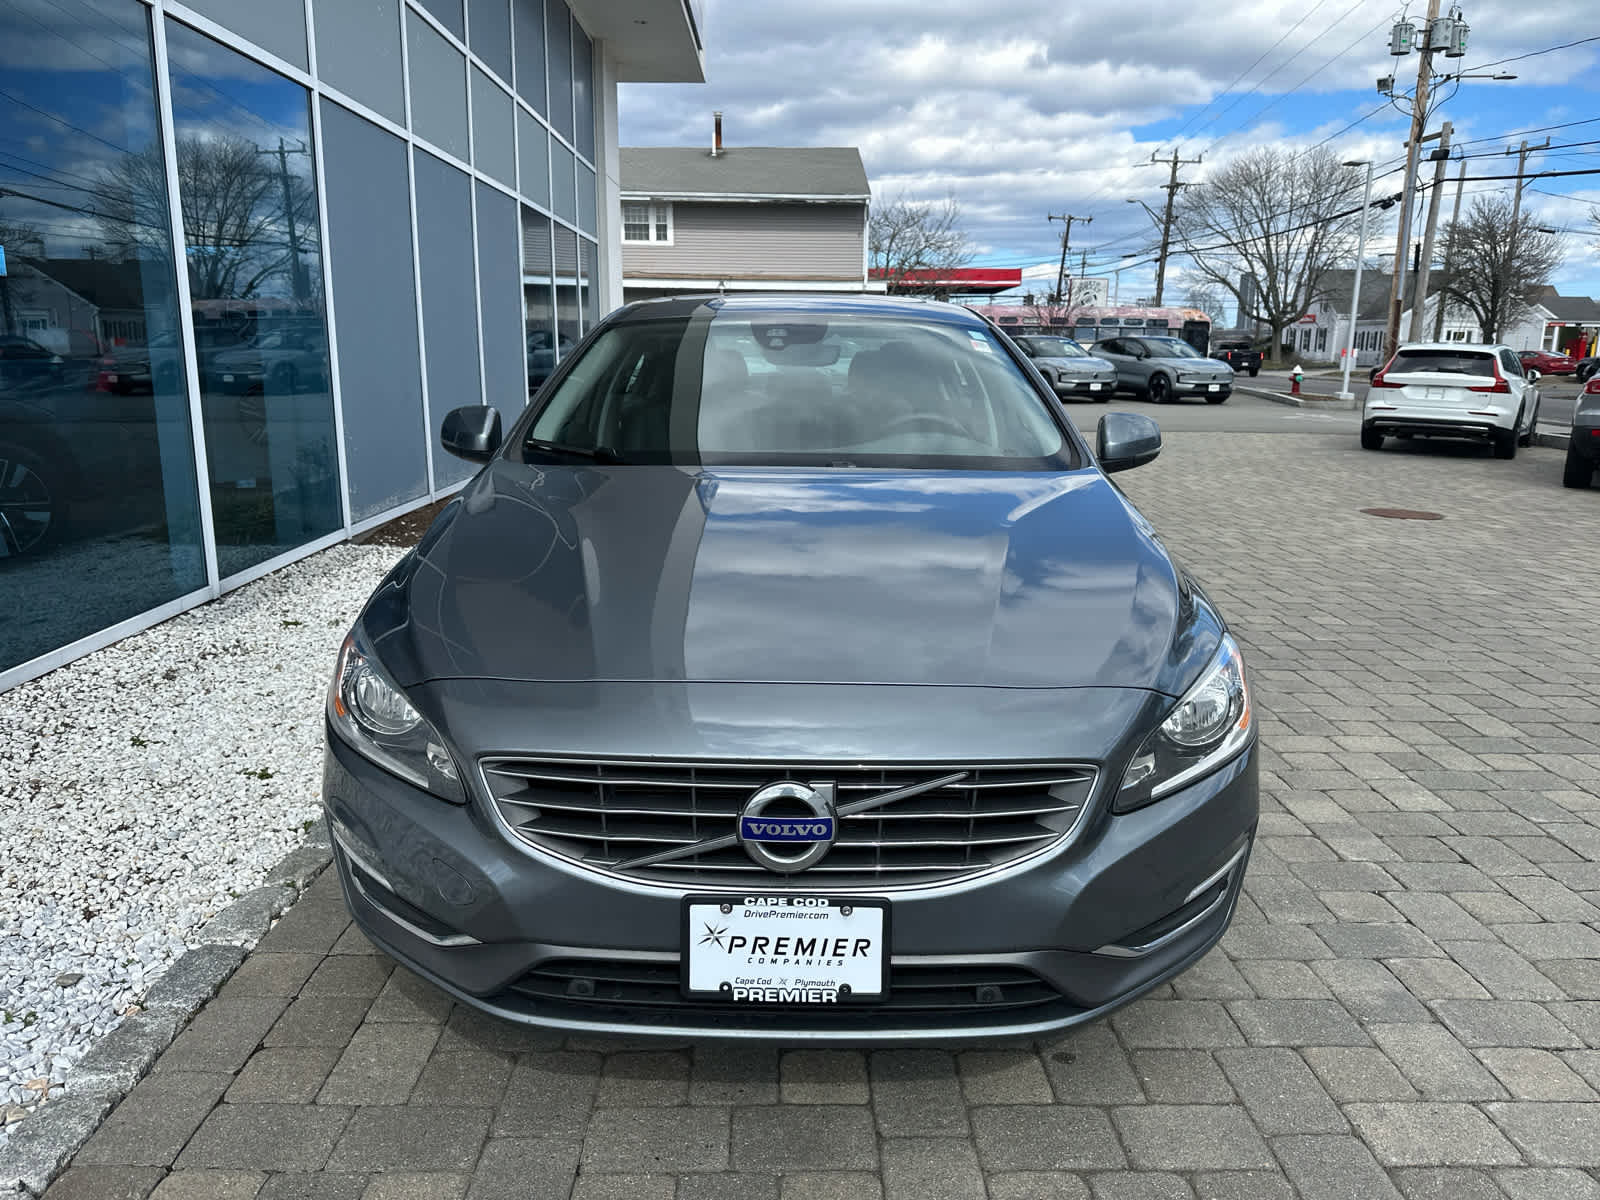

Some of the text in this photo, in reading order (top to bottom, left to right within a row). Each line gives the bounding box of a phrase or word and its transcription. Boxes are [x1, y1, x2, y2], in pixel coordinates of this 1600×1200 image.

[747, 823, 827, 836] VOLVO
[744, 897, 829, 908] CAPE COD
[744, 909, 829, 920] DrivePremier.com
[727, 935, 871, 957] PREMIER
[747, 957, 843, 966] COMPANIES
[735, 977, 836, 988] Cape Cod Plymouth
[733, 987, 838, 1003] PREMIER
